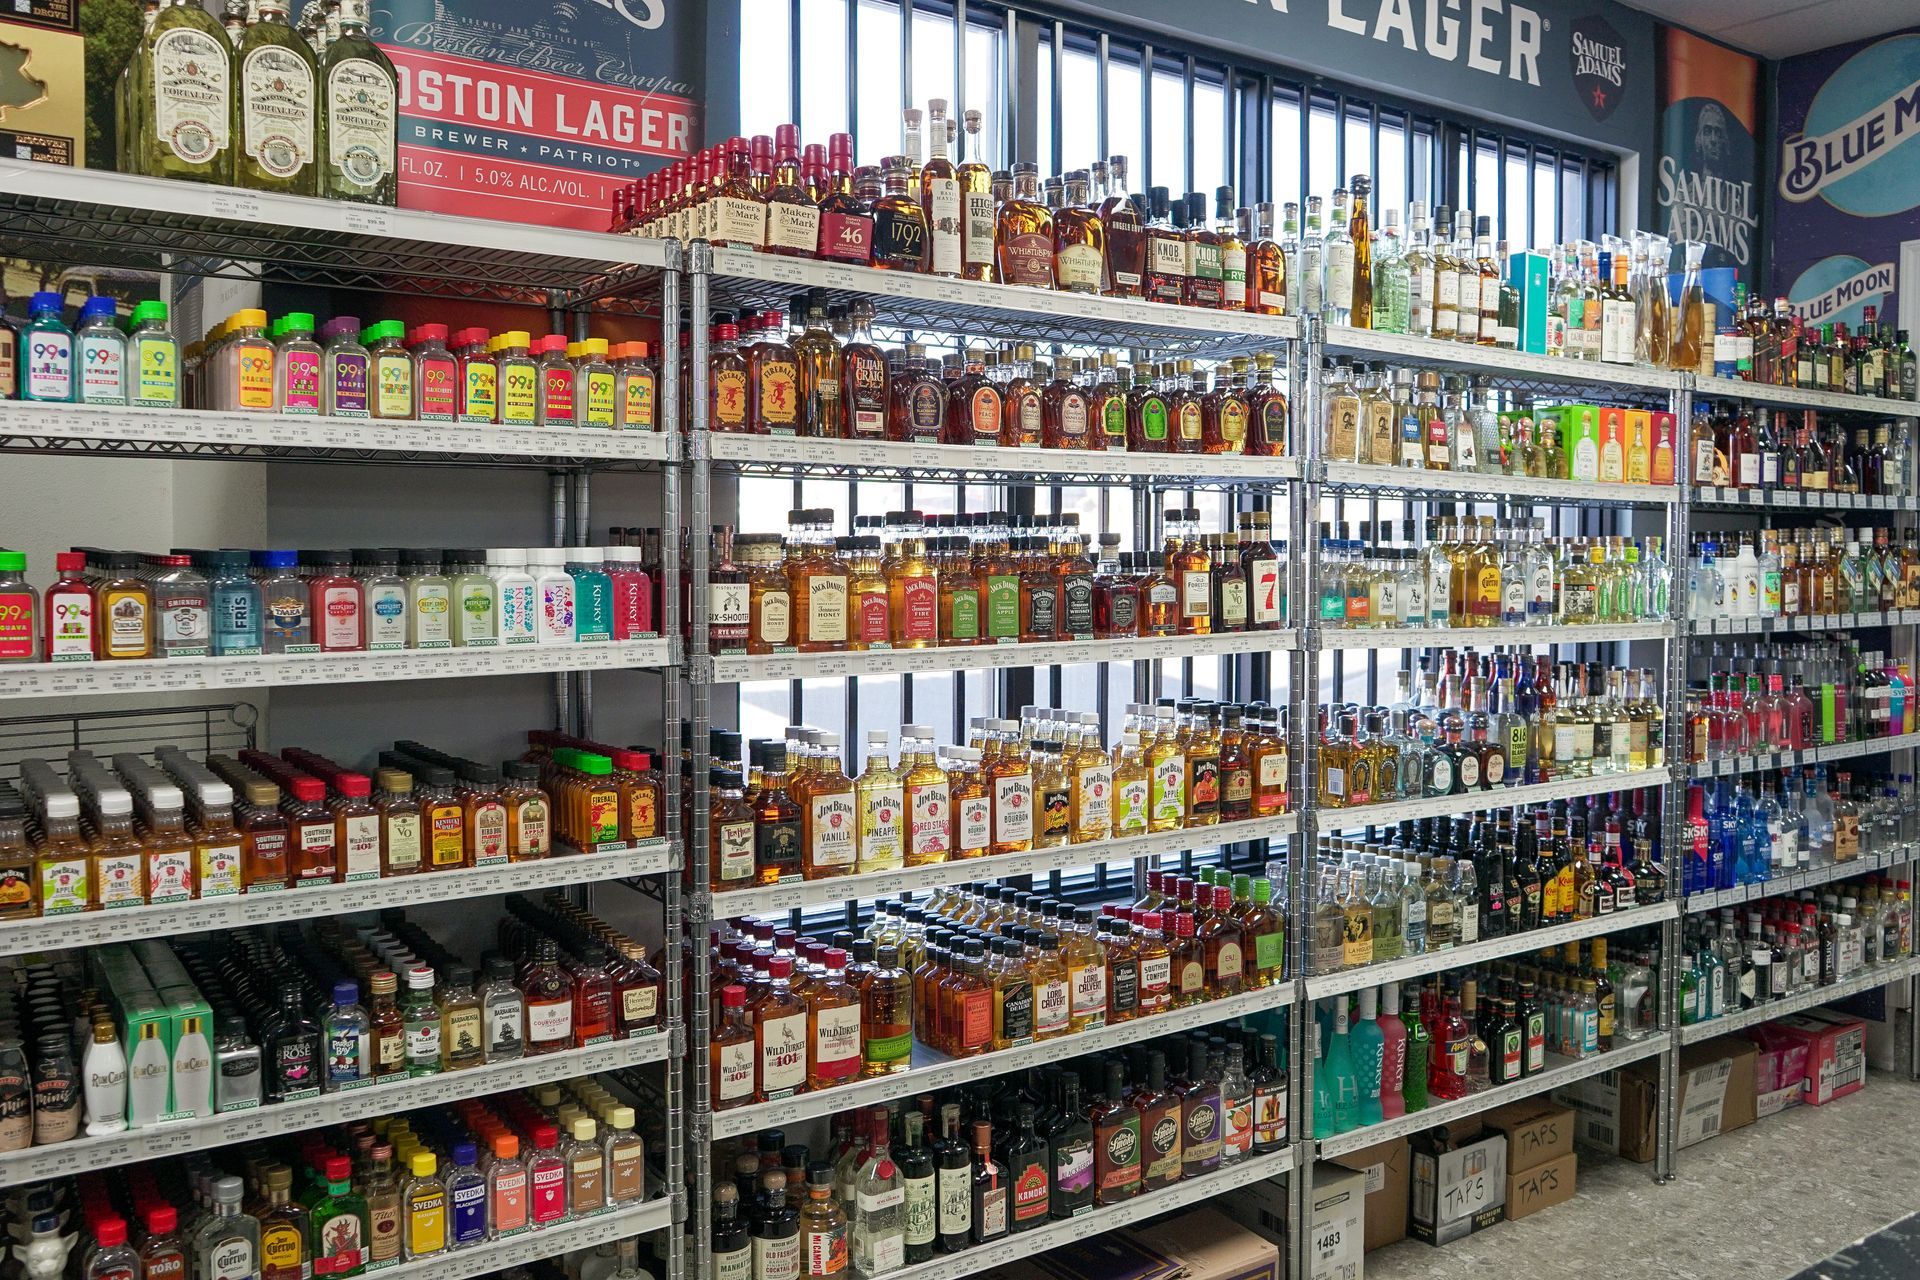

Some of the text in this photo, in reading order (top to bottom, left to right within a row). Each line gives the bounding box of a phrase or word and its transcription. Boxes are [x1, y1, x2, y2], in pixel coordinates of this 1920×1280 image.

[462, 16, 502, 30] BREWED
[511, 27, 529, 35] AND
[394, 20, 506, 59] Boston
[516, 42, 587, 73] Beer
[1572, 31, 1625, 70] SAMUEL
[1576, 60, 1622, 87] ADAMS
[415, 126, 509, 151] BREWER
[1786, 114, 1885, 195] BLUE
[475, 168, 513, 188] 5.0%
[520, 174, 590, 199] ALC./VOL.
[1657, 155, 1759, 229] SAMUEL
[726, 200, 761, 213] Maker's
[780, 206, 816, 219] Maker's
[735, 210, 760, 221] Mark
[790, 217, 815, 228] Mark
[840, 228, 862, 244] 46
[891, 222, 921, 246] 1792
[1668, 204, 1749, 266] ADAMS
[1158, 242, 1178, 257] KNOB
[1195, 246, 1216, 261] KNOB
[1231, 270, 1245, 281] RYE
[1837, 269, 1892, 307] MOON
[33, 344, 59, 358] 99
[86, 348, 109, 365] 99
[240, 357, 263, 373] 99
[338, 363, 357, 378] 99
[857, 357, 883, 371] ELIJAH
[763, 363, 796, 380] FIREBALL
[856, 369, 883, 382] CRAIG
[717, 372, 745, 386] FIREBALL
[134, 399, 152, 407] BACK
[811, 583, 825, 595] JACK
[906, 582, 918, 594] JACK
[990, 582, 1002, 593] JACK
[1065, 579, 1077, 592] JACK
[1260, 573, 1277, 610] 7
[167, 599, 204, 607] SMIRNOFF
[515, 586, 523, 626] KINKY
[555, 586, 563, 624] KINKY
[593, 584, 601, 624] KINKY
[275, 607, 301, 616] TAAKA
[1512, 727, 1526, 741] 818
[1084, 773, 1110, 789] JIM BEAM
[1000, 782, 1030, 800] JIM BEAM
[1164, 790, 1178, 798] APPLE
[592, 795, 617, 804] FIREBALL
[917, 789, 947, 807] JIM BEAM
[817, 800, 853, 818] JIM BEAM
[868, 797, 901, 814] JIM BEAM
[1089, 800, 1107, 810] HONEY
[1004, 814, 1028, 823] BOURBON
[397, 827, 412, 838] VO
[867, 825, 901, 837] PINEAPPLE
[919, 821, 932, 831] RED
[256, 834, 285, 844] SOUTHERN
[304, 829, 333, 837] SOUTHERN
[821, 831, 850, 842] VANILLA
[258, 841, 283, 850] COMFORT
[306, 836, 331, 844] COMFORT
[356, 842, 372, 850] 101
[157, 857, 185, 869] JIM BEAM
[208, 852, 235, 863] JIM BEAM
[49, 866, 80, 878] JIM BEAM
[105, 861, 134, 873] JIM BEAM
[55, 886, 75, 894] APPLE
[109, 881, 130, 889] HONEY
[1144, 964, 1168, 974] SOUTHERN
[1146, 970, 1167, 980] COMFORT
[1083, 974, 1098, 984] LORD
[1046, 990, 1062, 1000] LORD
[1006, 998, 1032, 1008] CANADIAN
[1041, 996, 1066, 1008] CALVERT
[533, 1017, 569, 1026] COURVOISIER
[819, 1023, 859, 1038] WILD TURKEY
[332, 1039, 354, 1049] PARROT
[415, 1036, 436, 1044] BACARDI
[283, 1048, 311, 1060] ROSE
[766, 1040, 805, 1056] WILD TURKEY
[776, 1053, 797, 1066] 101
[1376, 1043, 1384, 1086] KINKY
[1395, 1038, 1405, 1080] KINKY
[722, 1062, 753, 1074] WILD TURKEY
[730, 1071, 746, 1082] 101
[1521, 1123, 1558, 1156] TAPS
[535, 1170, 563, 1181] SVEDKA
[498, 1178, 525, 1188] SVEDKA
[1518, 1168, 1558, 1204] TAPS
[456, 1188, 484, 1199] SVEDKA
[1018, 1186, 1046, 1202] KAMORA
[1444, 1176, 1484, 1213] TAPS
[413, 1199, 443, 1211] SVEDKA
[1476, 1206, 1501, 1225] PREMIUM
[1482, 1217, 1495, 1227] BEER
[266, 1240, 296, 1255] Cuervo
[1317, 1231, 1341, 1251] 1483
[217, 1253, 247, 1268] Cuervo
[149, 1260, 181, 1275] TORO
[766, 1265, 790, 1273] COCKTAIL
